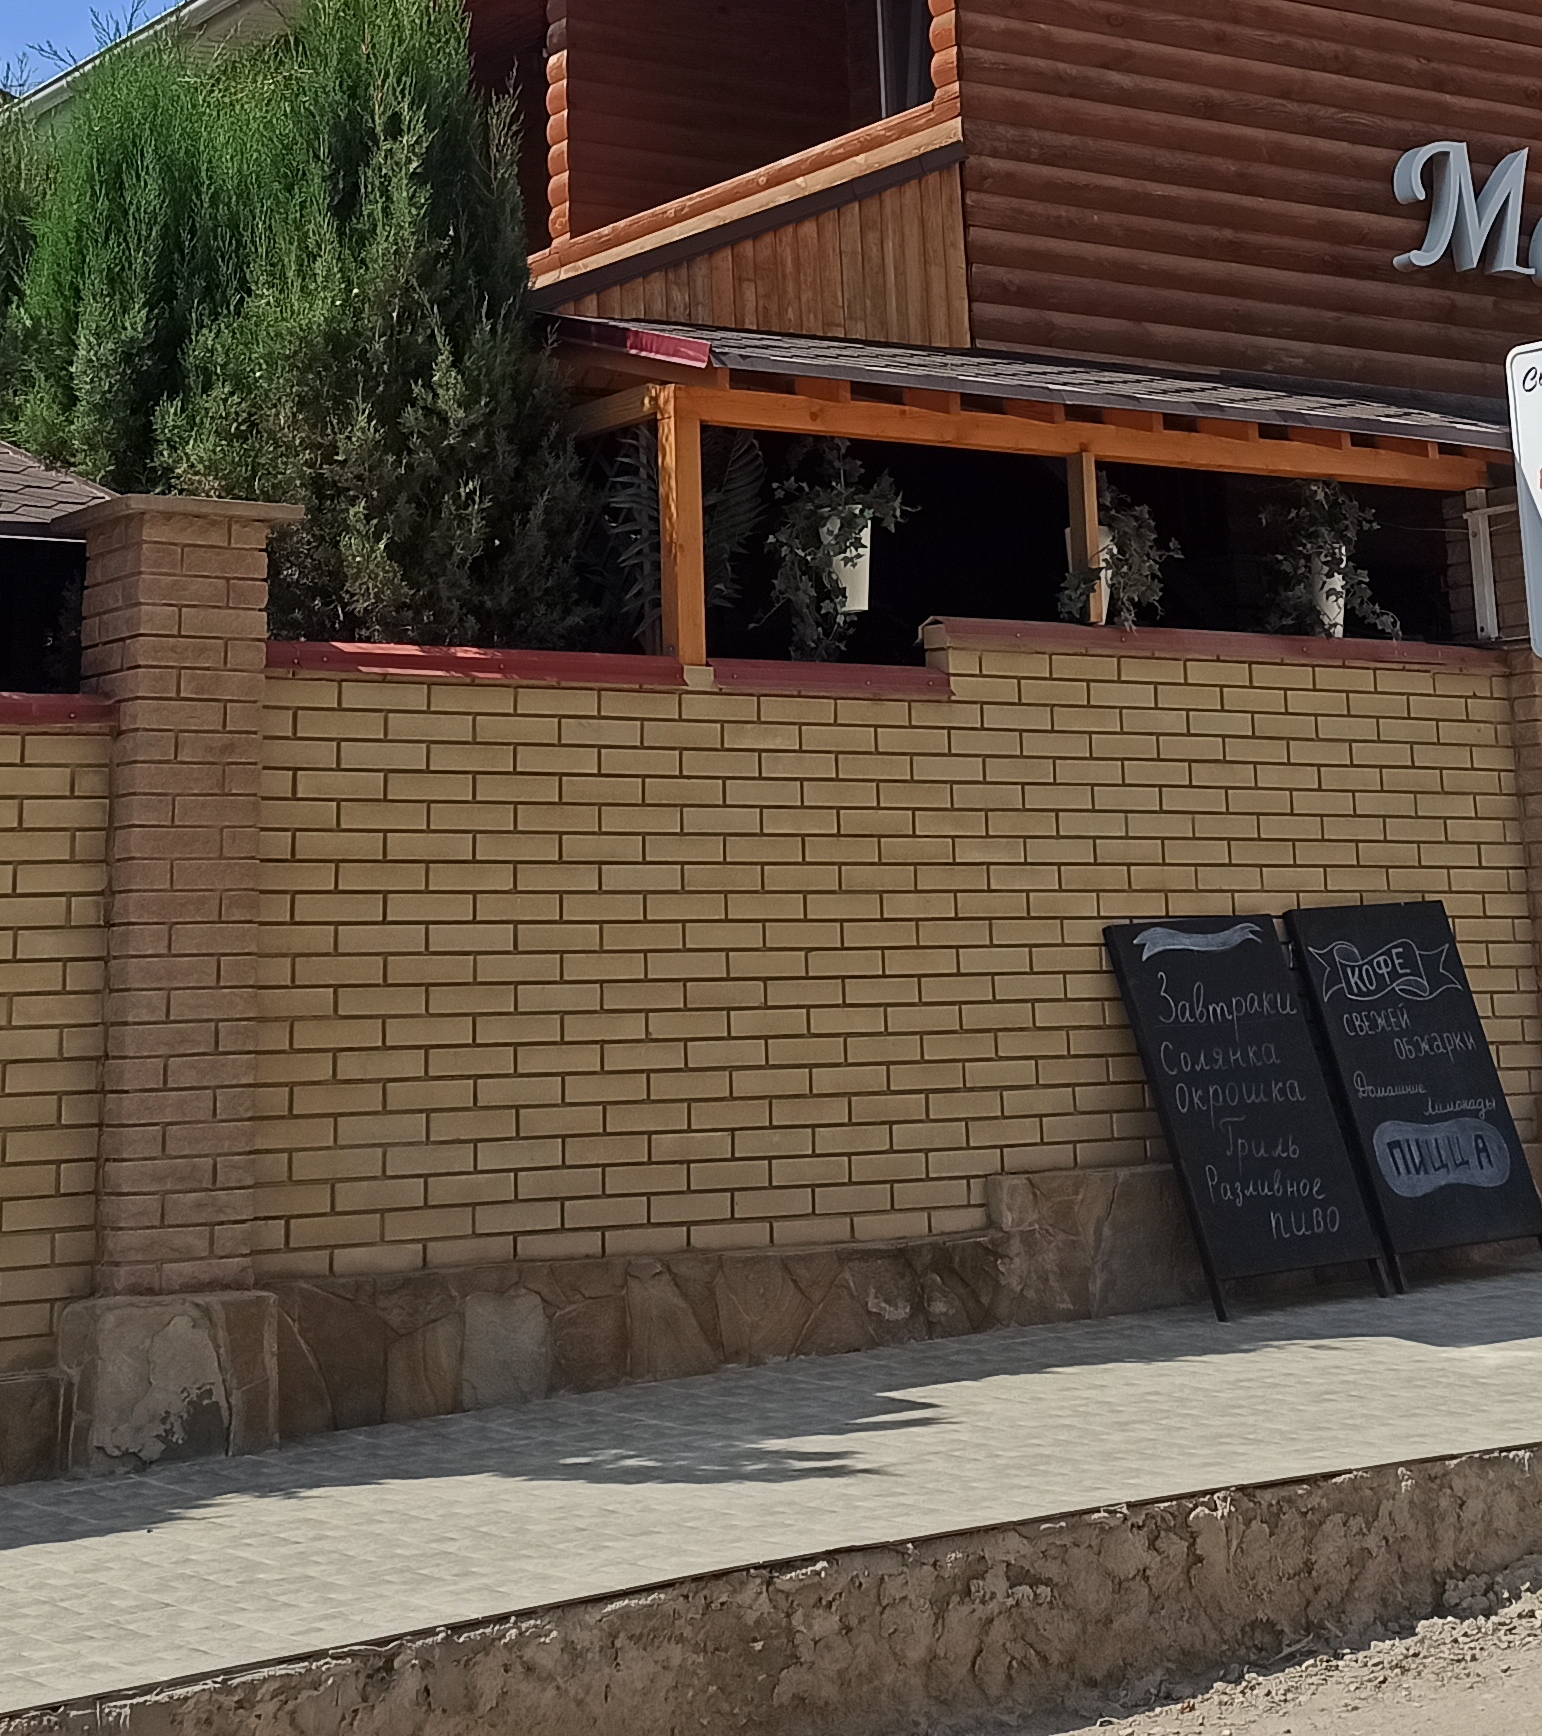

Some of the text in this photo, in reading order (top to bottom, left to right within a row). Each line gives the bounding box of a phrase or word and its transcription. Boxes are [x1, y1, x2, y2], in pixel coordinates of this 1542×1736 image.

[1346, 948, 1411, 994] КОФЕ
[1157, 971, 1298, 1042] Завтраки
[1343, 1002, 1411, 1037] СВЕЖЕЙ
[1160, 1041, 1282, 1075] Солянка
[1175, 1079, 1307, 1131] Окрошка
[1353, 1070, 1427, 1099] Домашние
[1218, 1115, 1301, 1178] Гриль
[1386, 1133, 1495, 1178] ПИЦЦА
[1205, 1164, 1327, 1207] Разливное
